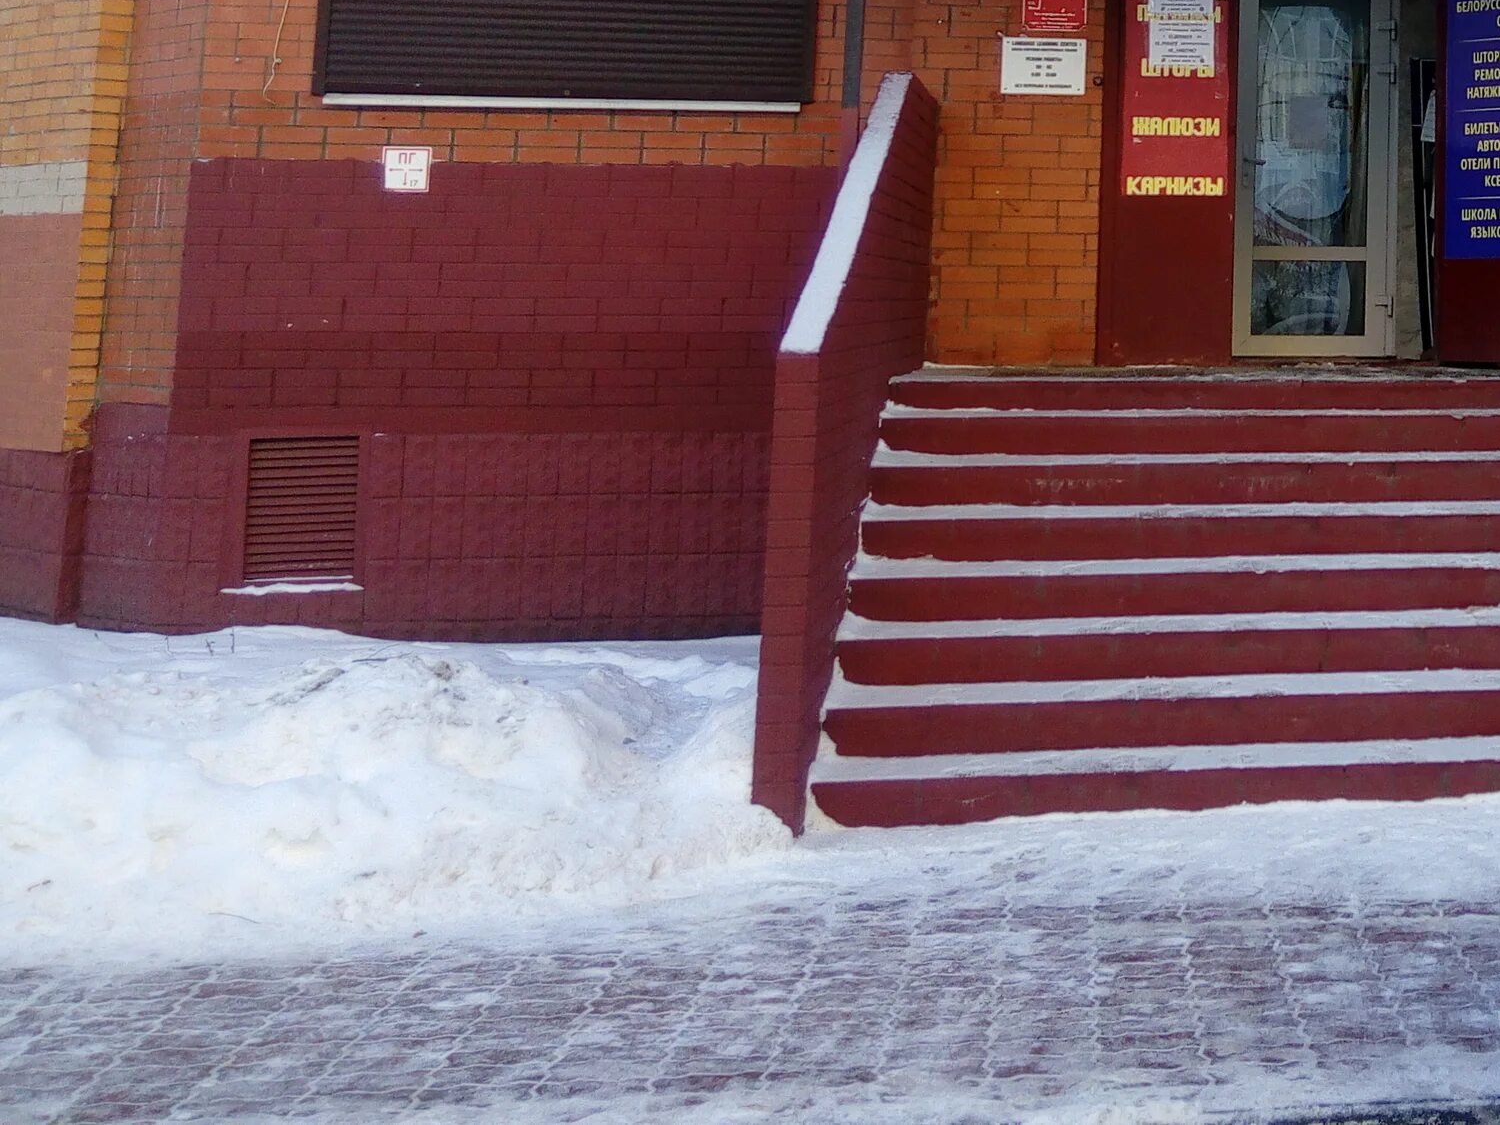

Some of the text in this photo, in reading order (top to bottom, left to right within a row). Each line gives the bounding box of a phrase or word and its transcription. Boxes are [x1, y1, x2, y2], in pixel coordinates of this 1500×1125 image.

[1132, 117, 1221, 137] ЖАЛЮЗИ
[399, 152, 416, 164] ПГ
[1460, 158, 1490, 170] ОТЕЛИ
[1126, 176, 1224, 196] КАРНИЗЫ
[1461, 208, 1497, 221] ШКОЛА
